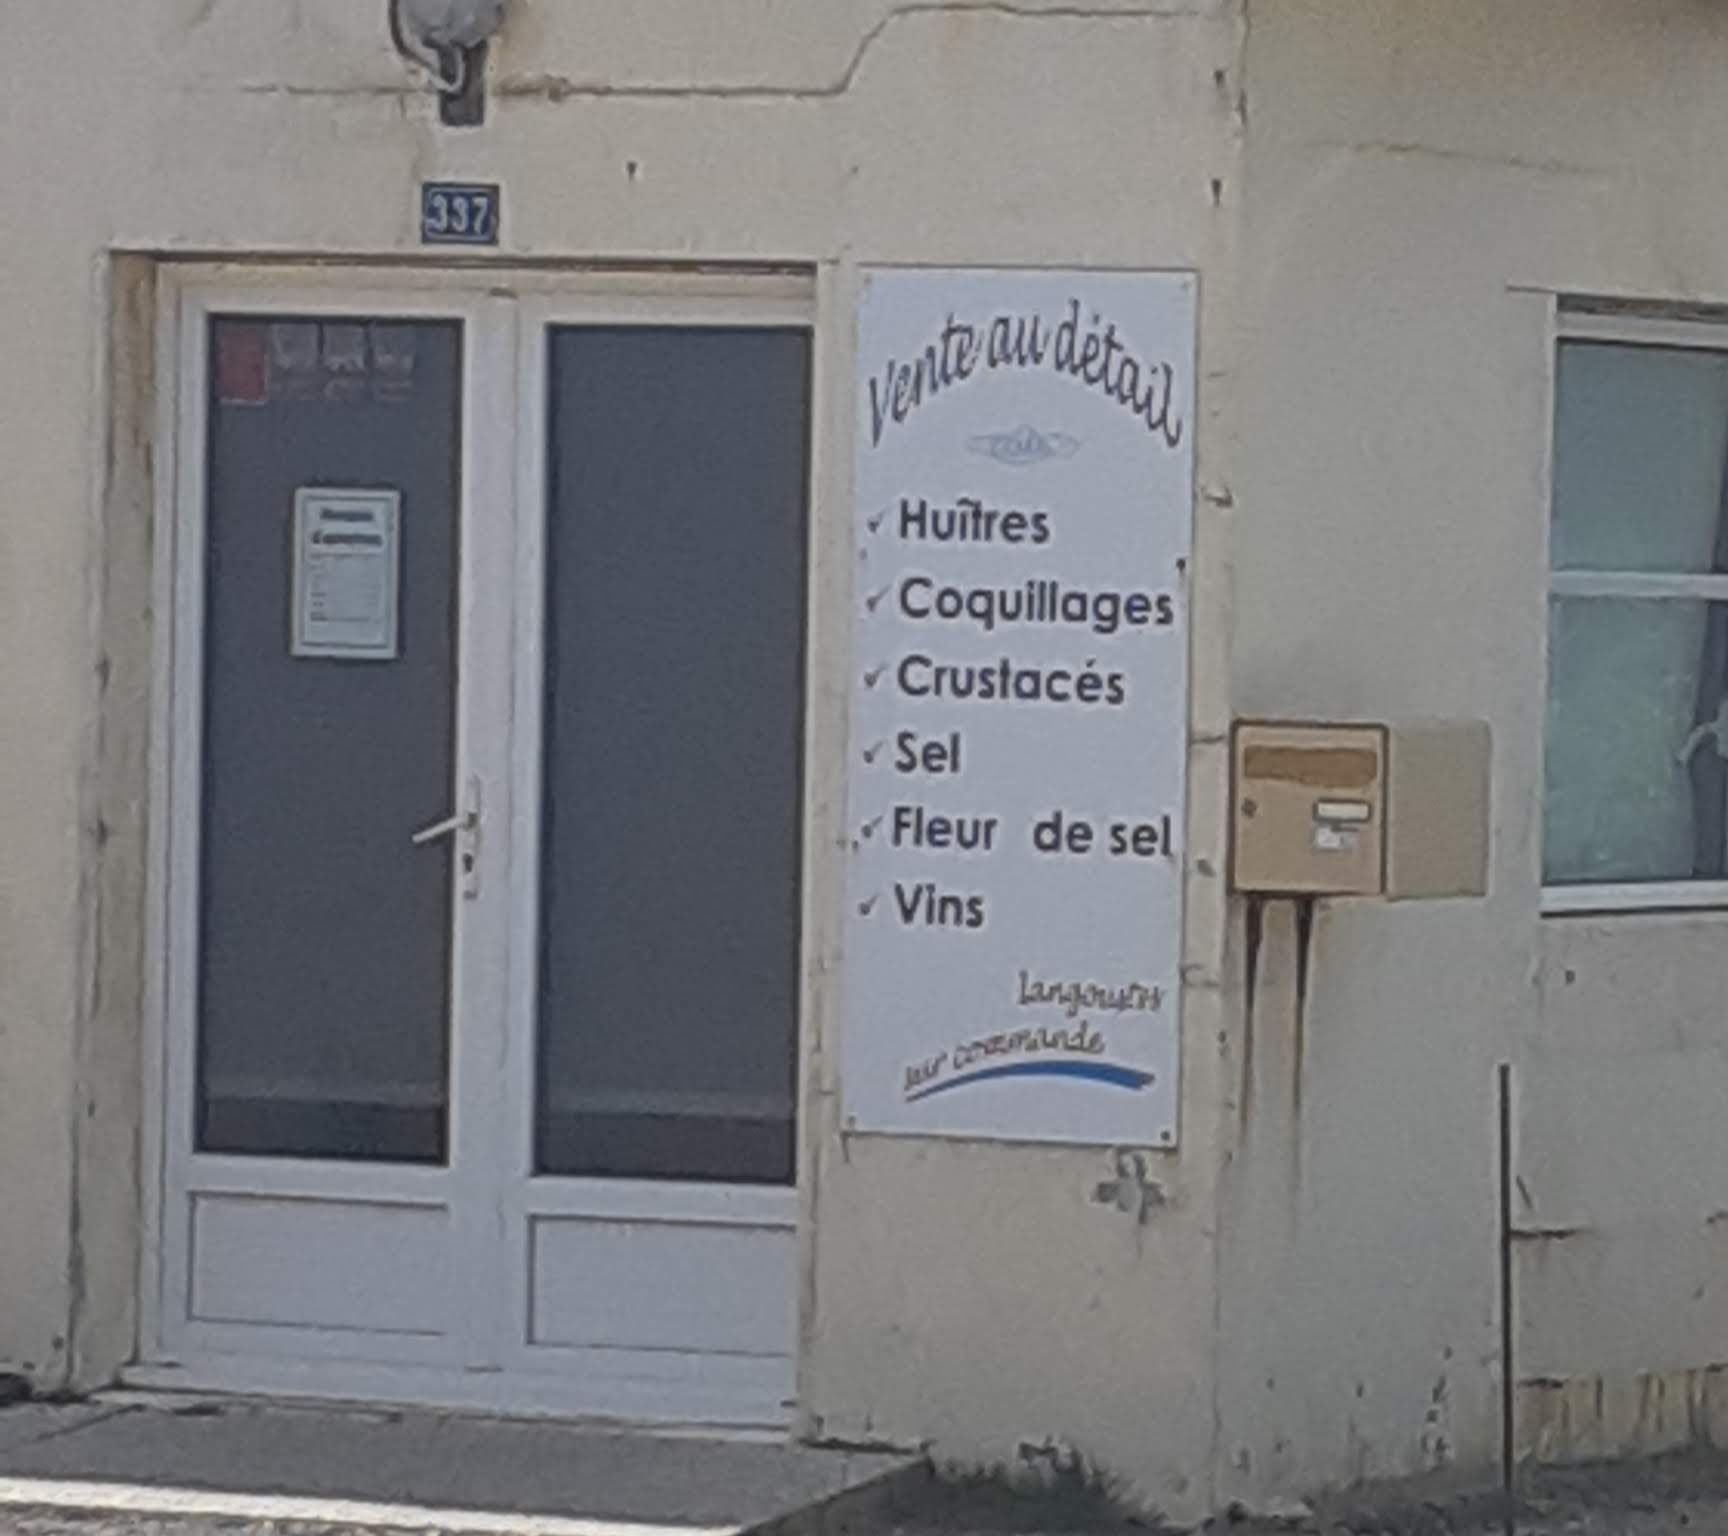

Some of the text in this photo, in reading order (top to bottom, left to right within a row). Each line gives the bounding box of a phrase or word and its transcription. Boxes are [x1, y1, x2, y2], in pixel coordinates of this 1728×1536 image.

[426, 194, 489, 235] 337
[868, 297, 1184, 449] Vente au détail
[899, 497, 1051, 545] Huîtres
[898, 576, 1175, 634] Coquillages
[896, 654, 1127, 706] Crustacés
[894, 731, 961, 774] Sel
[891, 806, 1174, 858] Fleur de sel
[893, 882, 986, 929] Vins
